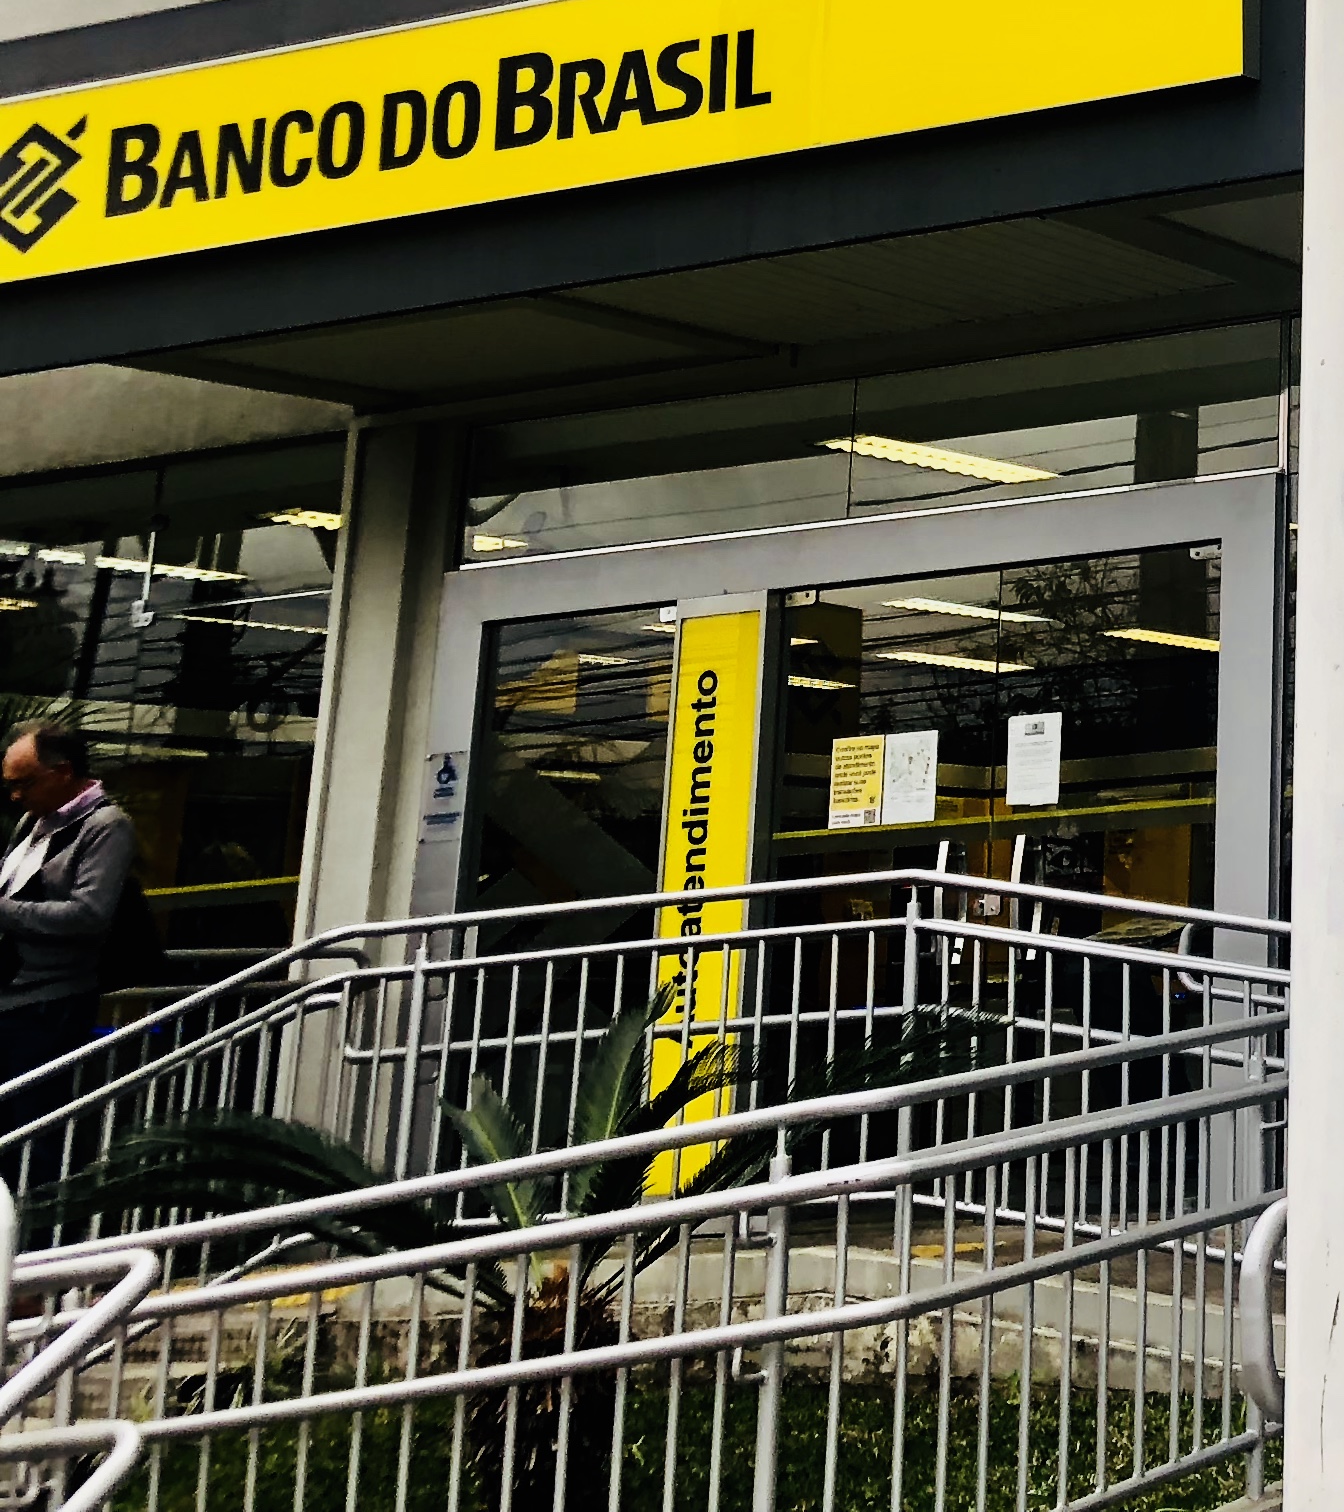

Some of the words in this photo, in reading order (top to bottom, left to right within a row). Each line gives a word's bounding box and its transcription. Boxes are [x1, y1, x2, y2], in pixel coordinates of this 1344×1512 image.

[103, 100, 366, 219] BANCO
[377, 78, 482, 172] DO
[492, 27, 773, 152] BRASIL
